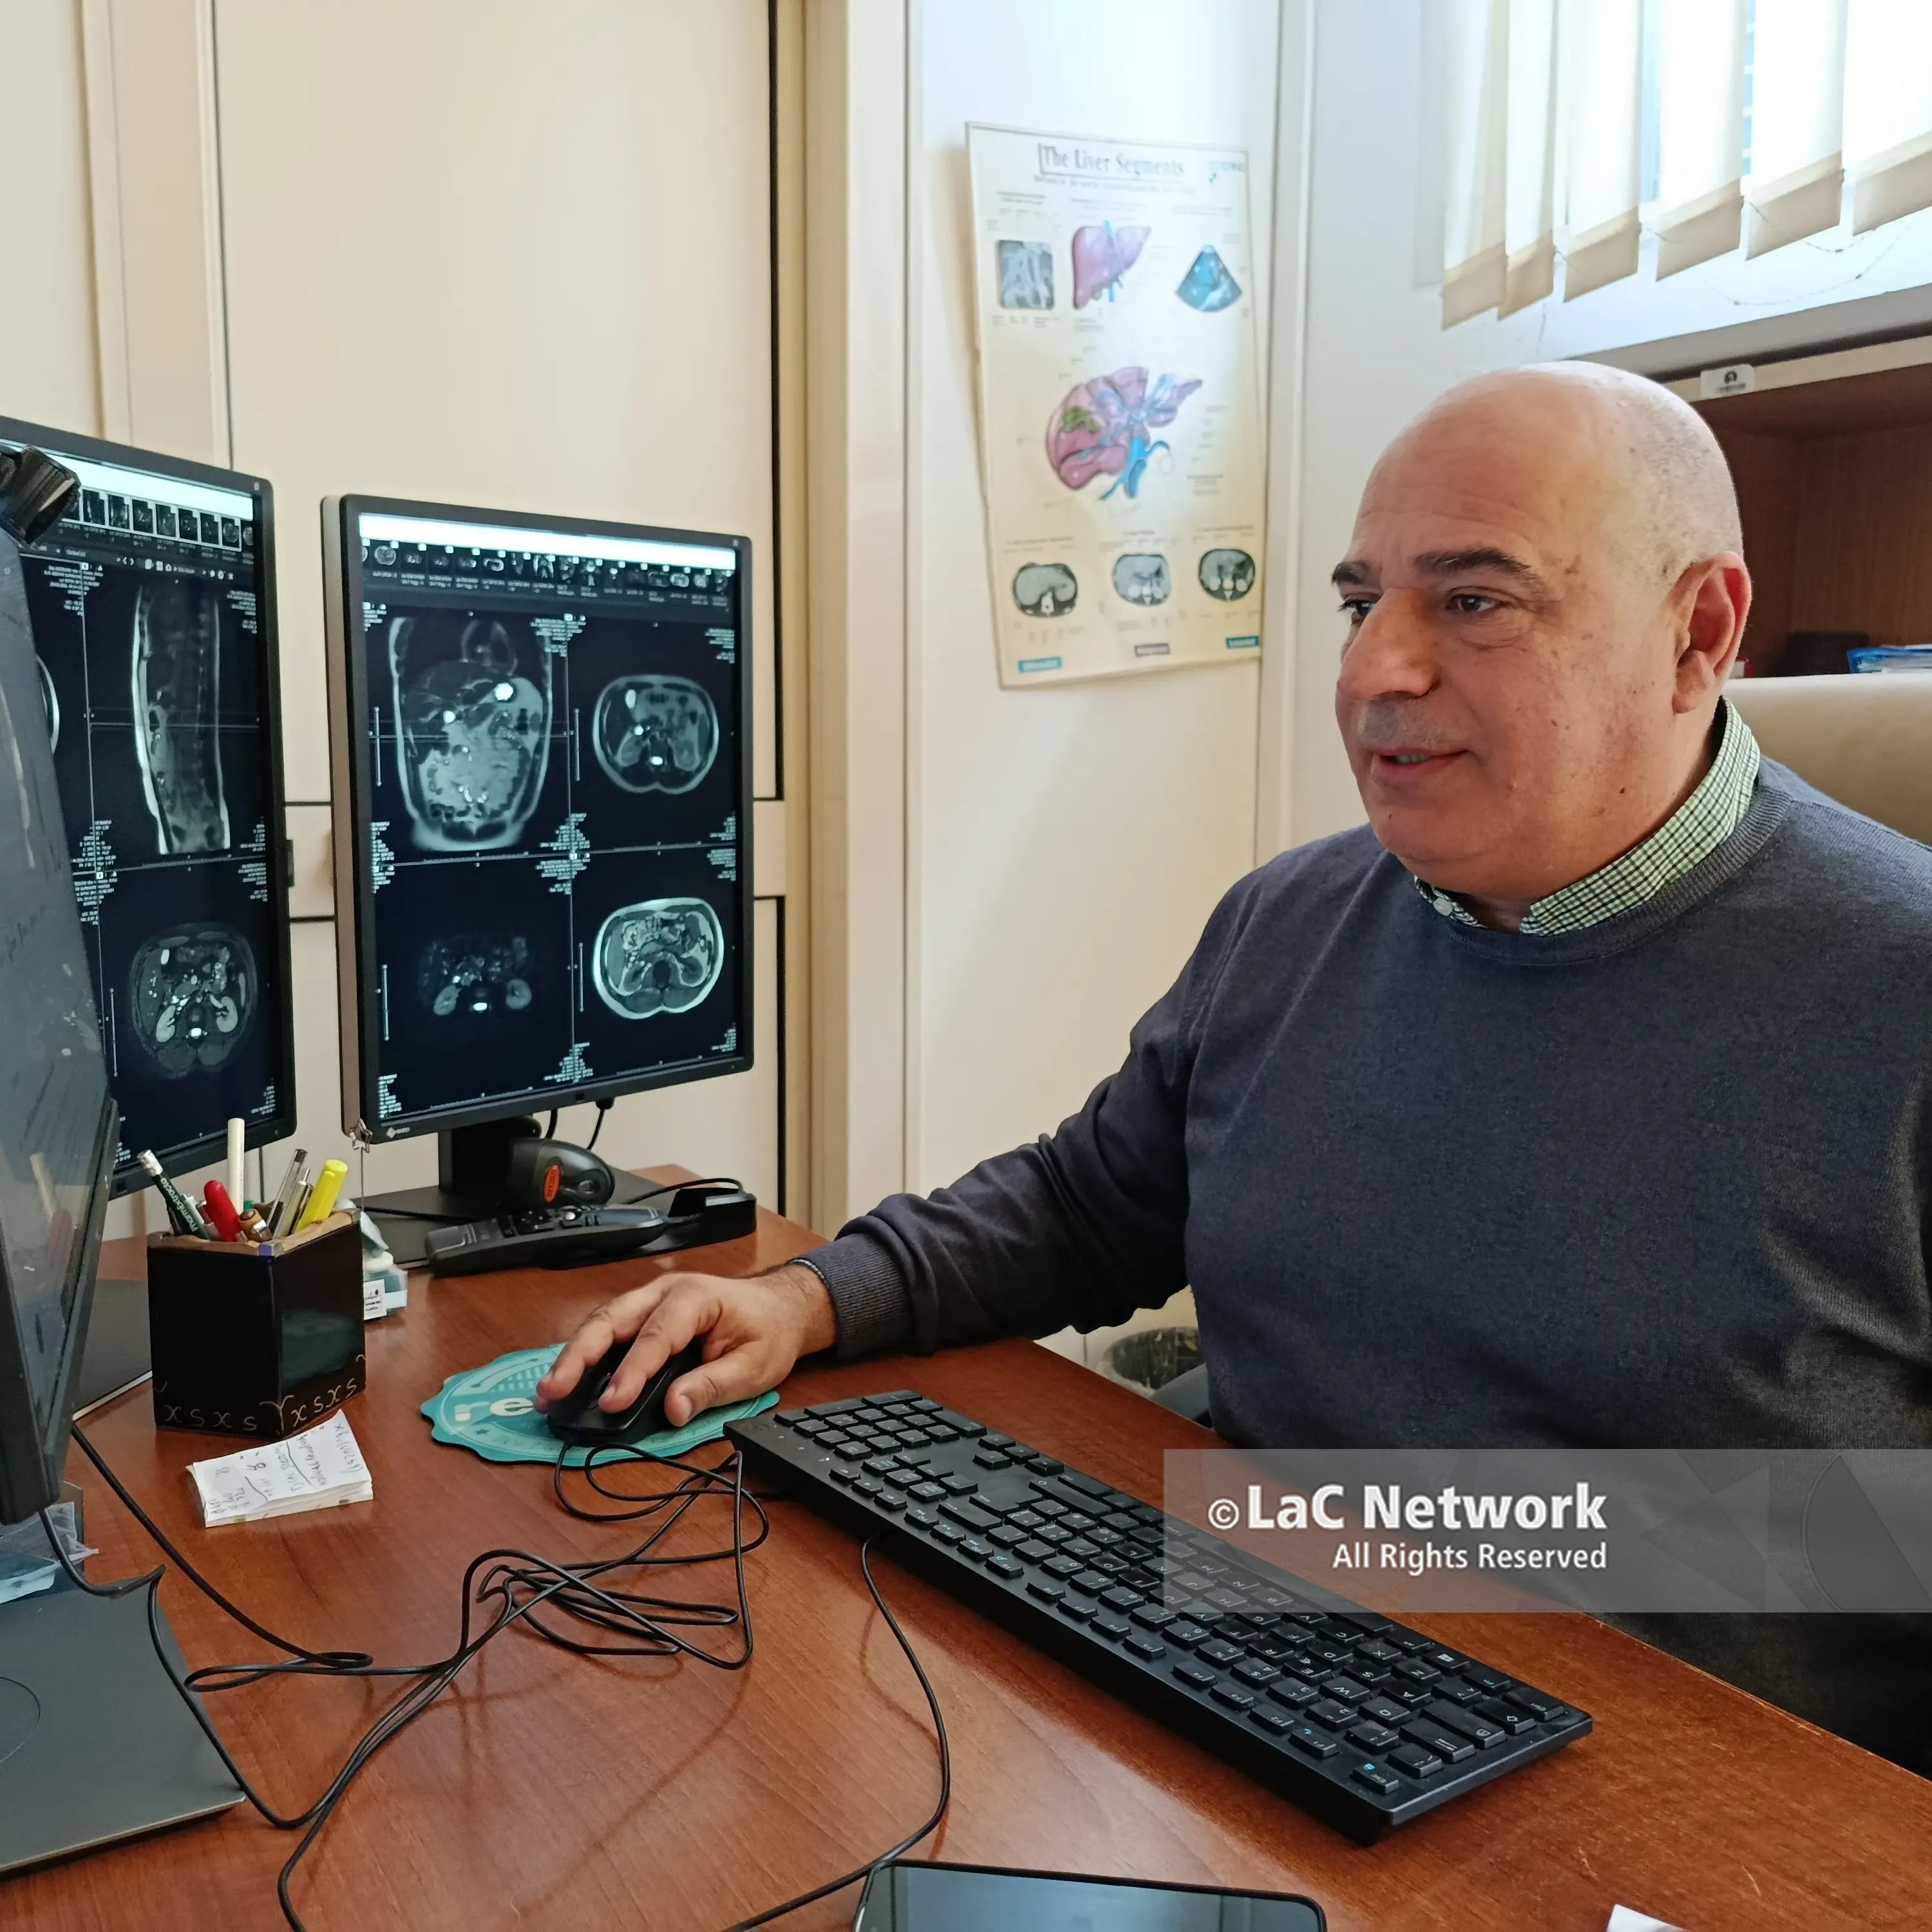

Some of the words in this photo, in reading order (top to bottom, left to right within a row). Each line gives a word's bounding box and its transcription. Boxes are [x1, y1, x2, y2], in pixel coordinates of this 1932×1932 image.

[1043, 144, 1069, 169] The
[1075, 149, 1112, 172] Liver
[1116, 153, 1186, 176] Segments
